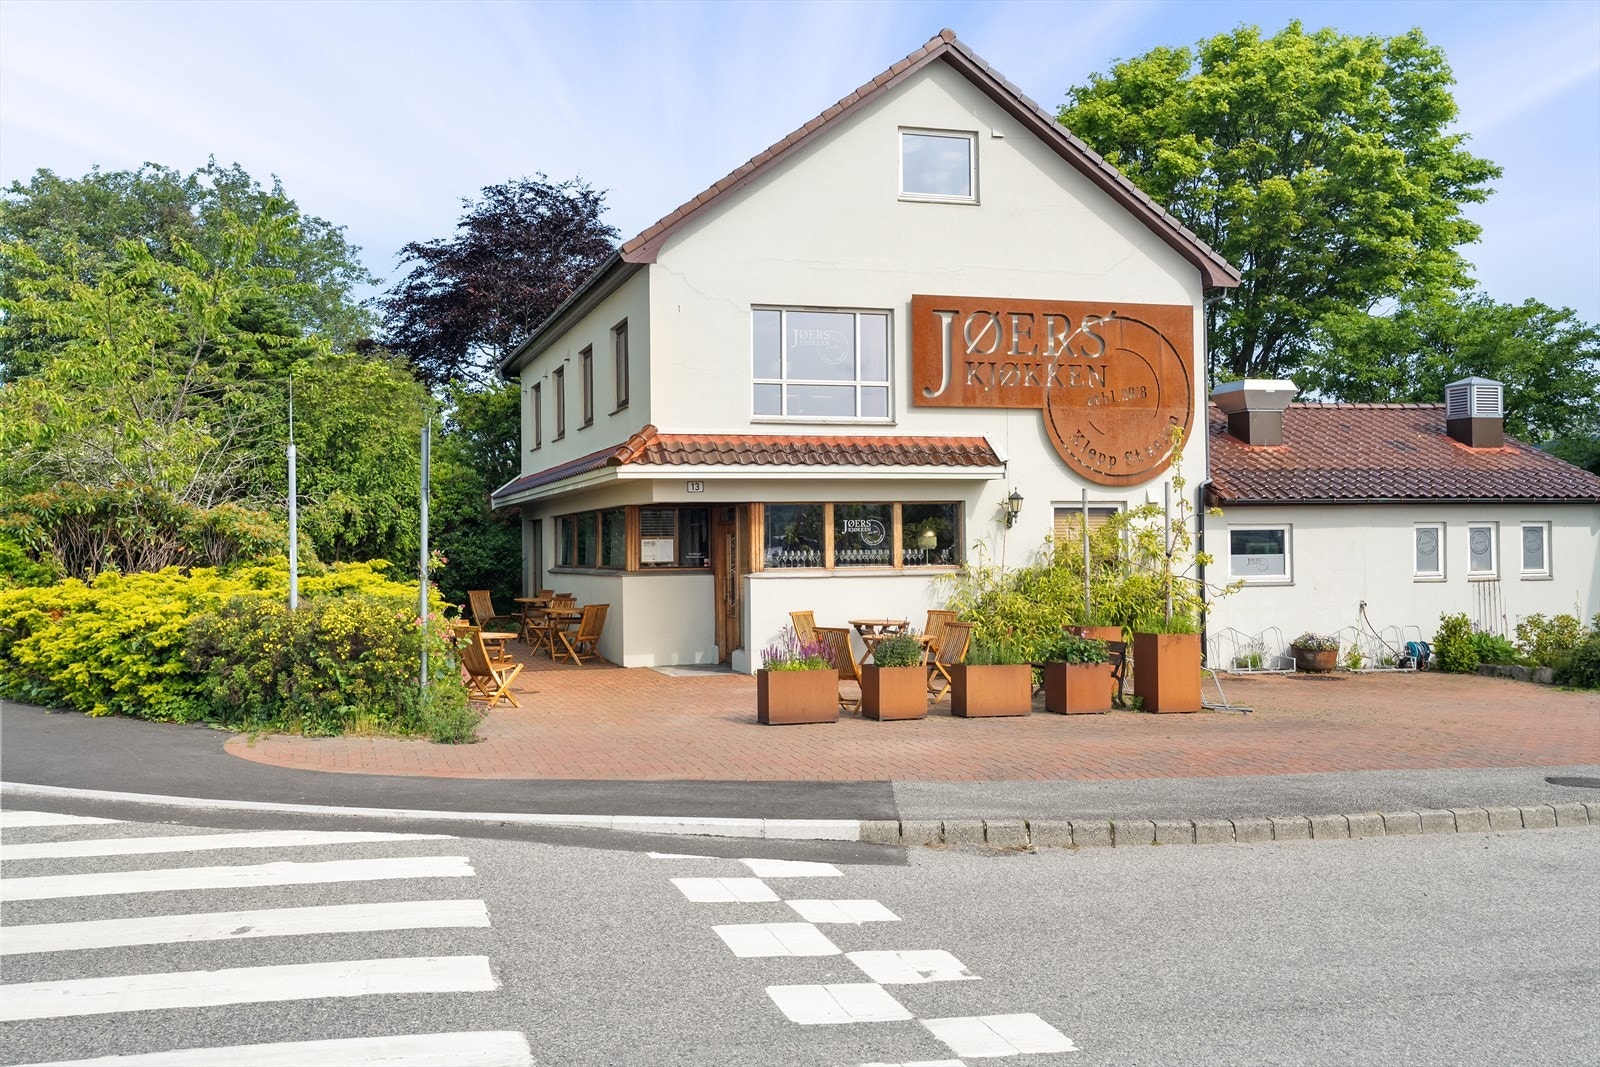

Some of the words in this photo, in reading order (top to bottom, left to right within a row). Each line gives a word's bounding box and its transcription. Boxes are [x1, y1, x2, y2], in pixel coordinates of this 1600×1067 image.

[790, 329, 831, 348] JØERS
[922, 309, 1106, 398] JØERS
[965, 361, 1107, 391] KJØKKEN
[1070, 429, 1117, 469] Klepp
[691, 483, 700, 491] 13
[841, 519, 872, 535] JØERS
